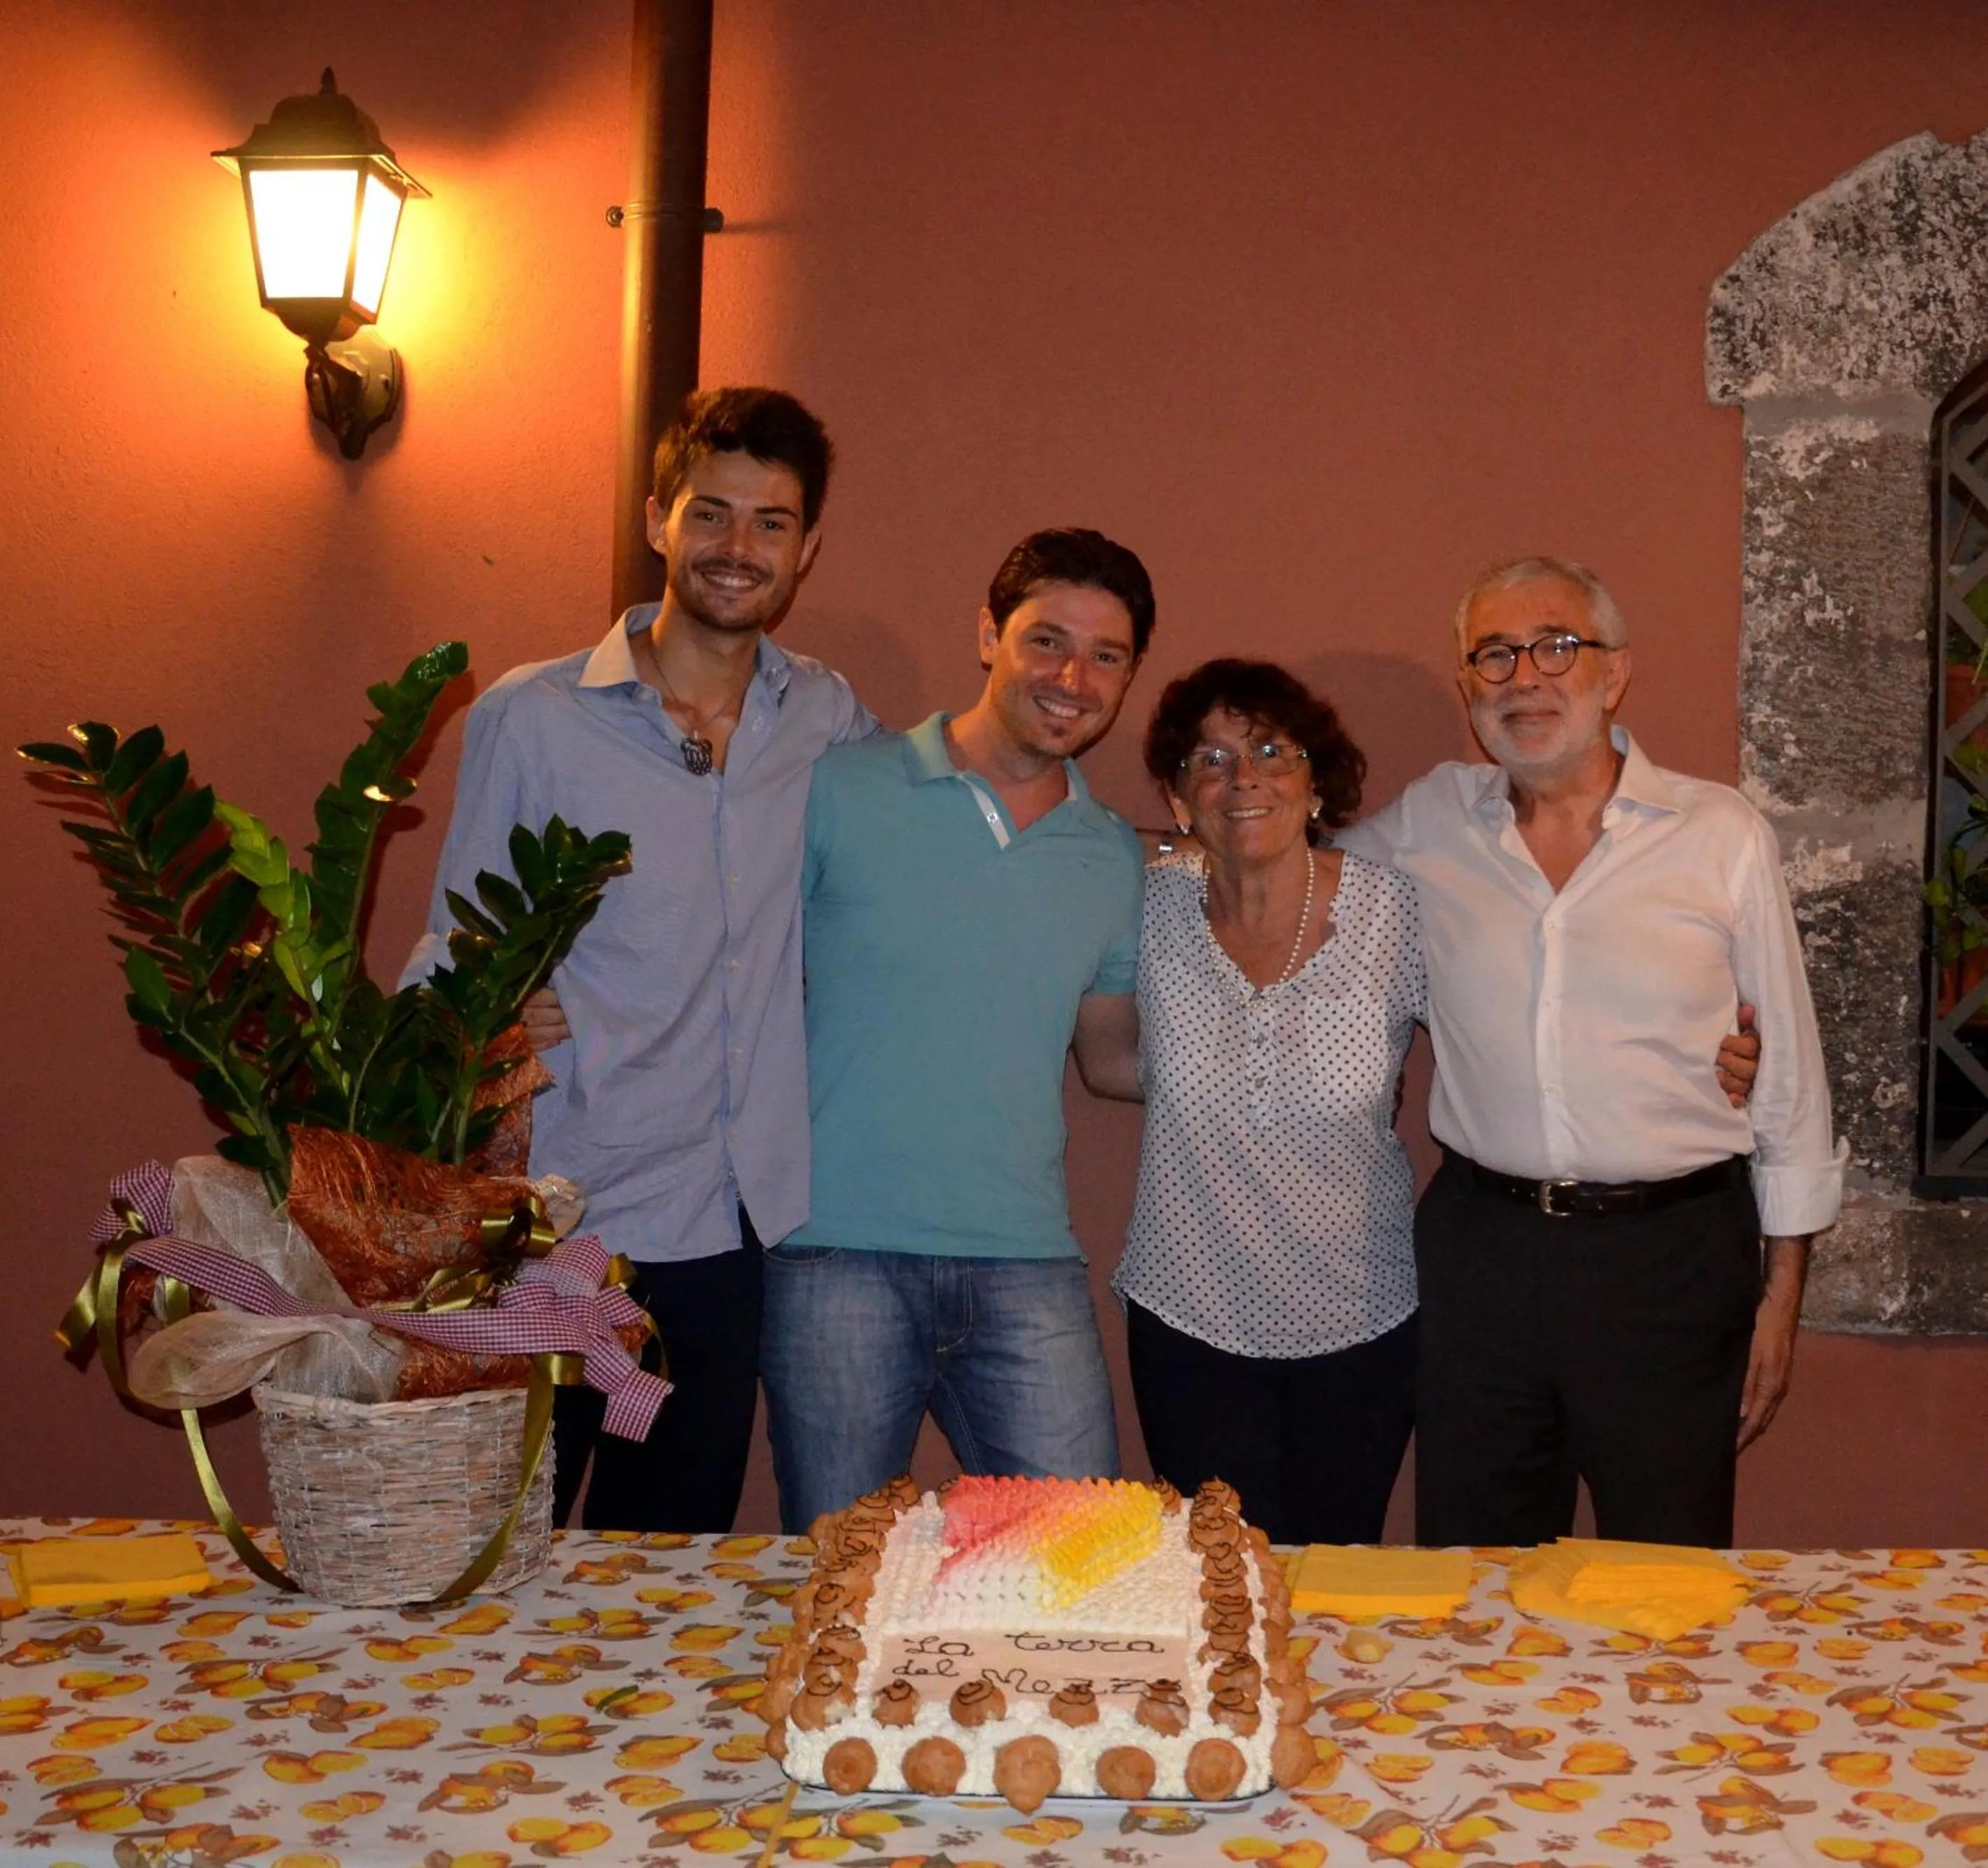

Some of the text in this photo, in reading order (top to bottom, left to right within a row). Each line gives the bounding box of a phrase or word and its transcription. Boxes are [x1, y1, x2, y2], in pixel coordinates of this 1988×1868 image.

[902, 1631, 1165, 1656] La terra
[892, 1658, 960, 1677] del
